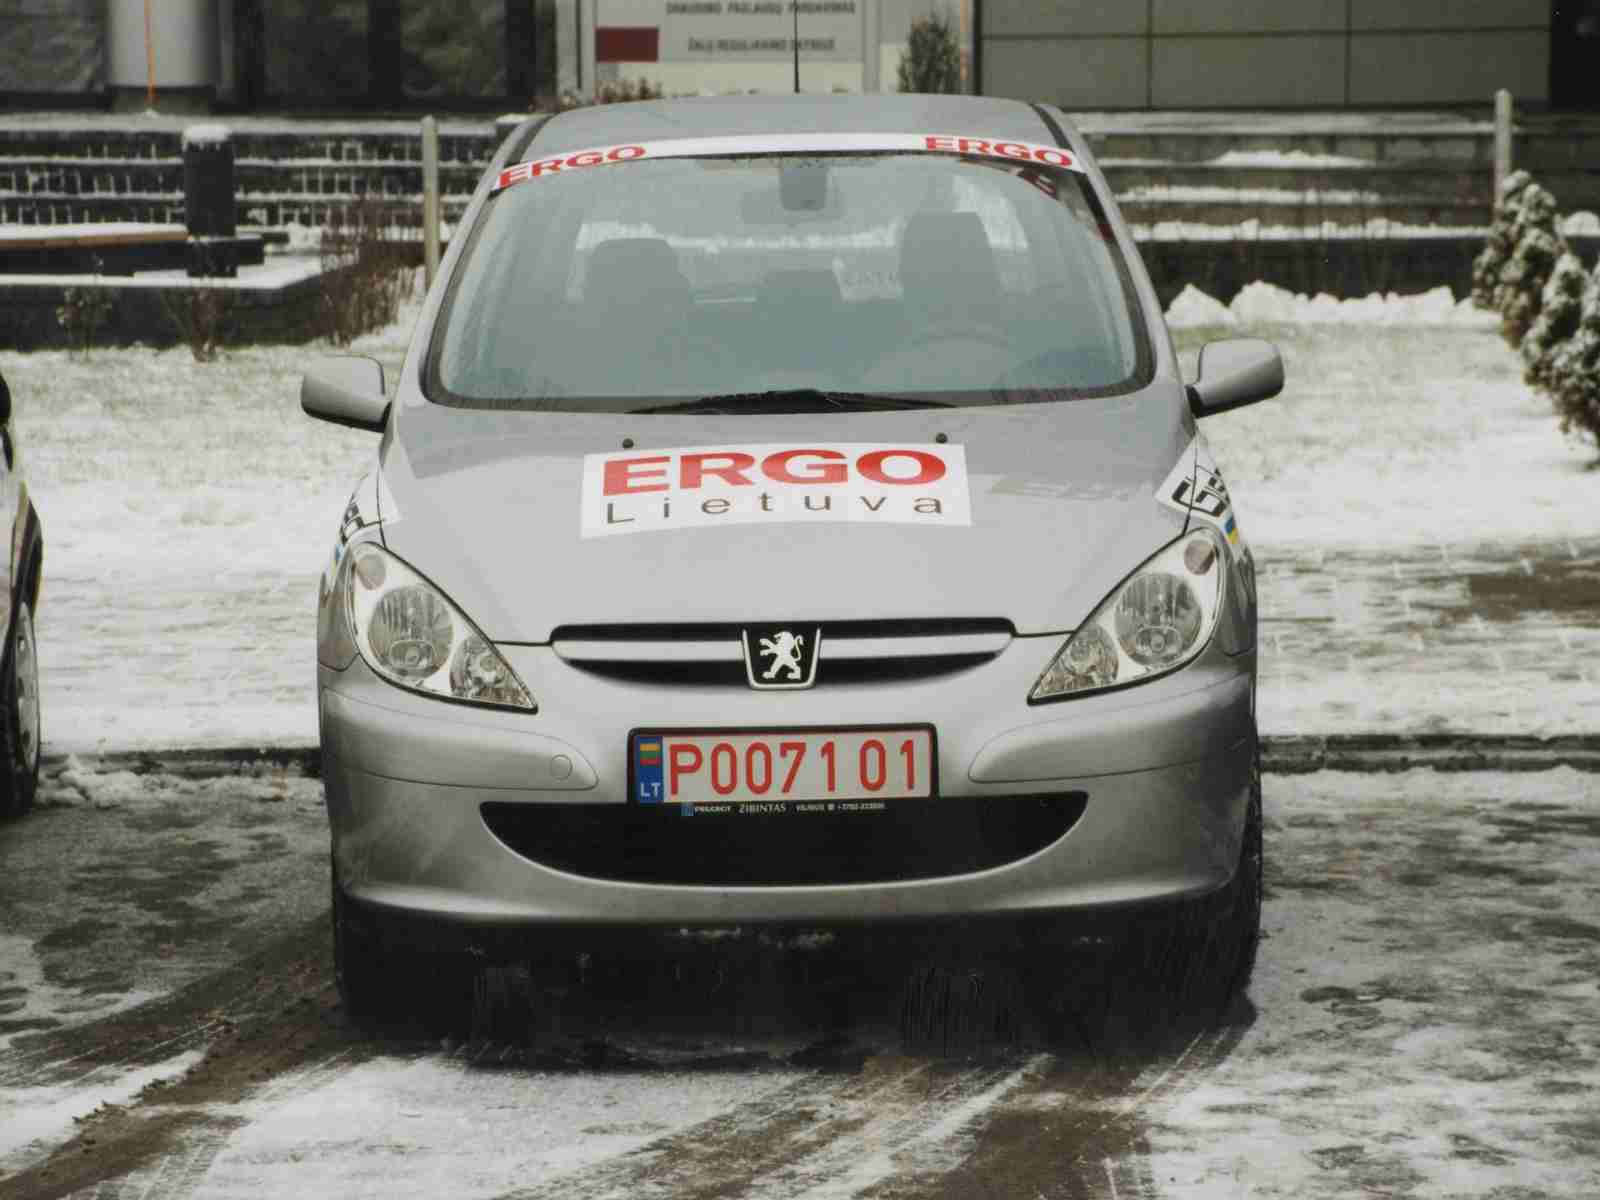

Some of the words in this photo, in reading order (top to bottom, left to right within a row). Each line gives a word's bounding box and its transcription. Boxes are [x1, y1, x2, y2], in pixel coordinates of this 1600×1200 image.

[500, 146, 646, 187] ERGO
[926, 137, 1073, 167] ERGO
[602, 449, 947, 496] ERGO
[606, 492, 944, 524] Lietuva
[640, 782, 661, 797] LT
